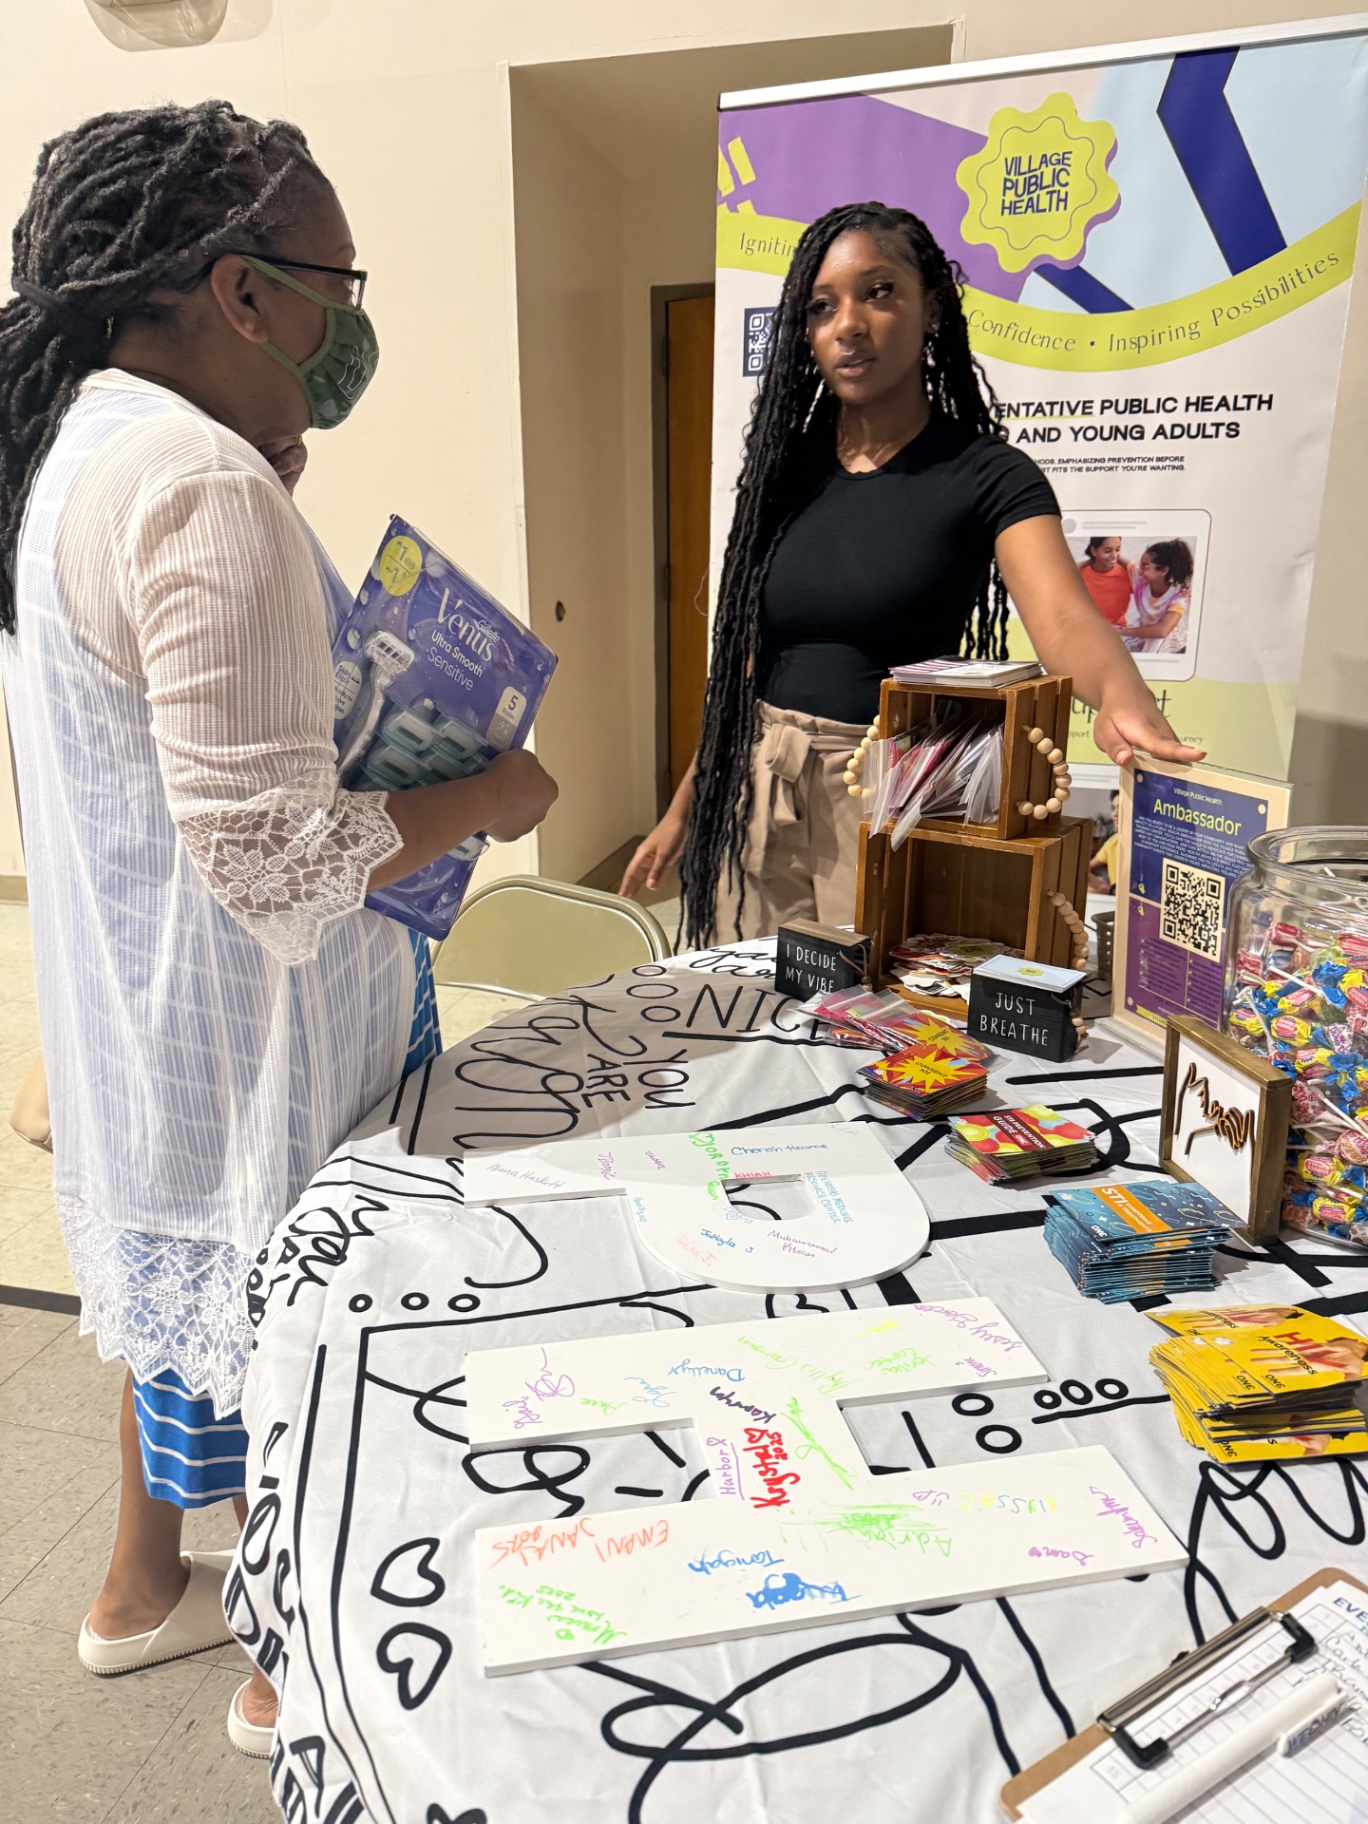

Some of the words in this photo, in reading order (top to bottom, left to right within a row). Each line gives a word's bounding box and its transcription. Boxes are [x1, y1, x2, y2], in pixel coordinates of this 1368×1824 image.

[1004, 151, 1073, 177] VILLAGE
[1002, 167, 1070, 198] PUBLIC
[1000, 189, 1069, 217] HEALTH
[967, 308, 1076, 352] Confidence
[1109, 320, 1201, 354] Inspiring
[1211, 250, 1340, 328] Possibilities
[994, 400, 1095, 419] ENTATIVE
[1100, 397, 1179, 415] PUBLIC
[1184, 393, 1274, 413] HEALTH
[1016, 426, 1062, 444] AND
[1069, 424, 1145, 442] YOUNG
[1152, 421, 1241, 440] ADULTS
[1057, 457, 1106, 465] EMPHASIZING
[1107, 456, 1154, 464] PREVENTION
[1155, 455, 1185, 463] BEFORE
[1085, 465, 1119, 473] SUPPORT
[437, 587, 496, 662] Venus
[475, 618, 501, 644] Gillette
[431, 628, 452, 654] Ultra
[451, 647, 484, 679] Smooth
[426, 646, 474, 692] Sensitive
[507, 694, 519, 712] 5
[1188, 791, 1205, 802] Public
[1205, 795, 1223, 806] Health
[1153, 798, 1243, 837] Ambassador
[786, 943, 791, 953] I
[796, 946, 837, 972] DECIDE
[785, 965, 803, 984] MY
[994, 992, 1037, 1016] JUST
[979, 1015, 1049, 1048] BREATHE
[581, 1053, 632, 1108] ARE
[915, 1060, 949, 1080] CONSENT
[992, 1115, 1017, 1136] GUIDE
[1011, 1119, 1046, 1150] PREVENTION
[1100, 1185, 1126, 1208] STI
[1257, 1335, 1318, 1377] Awareness
[1272, 1330, 1347, 1369] HIV
